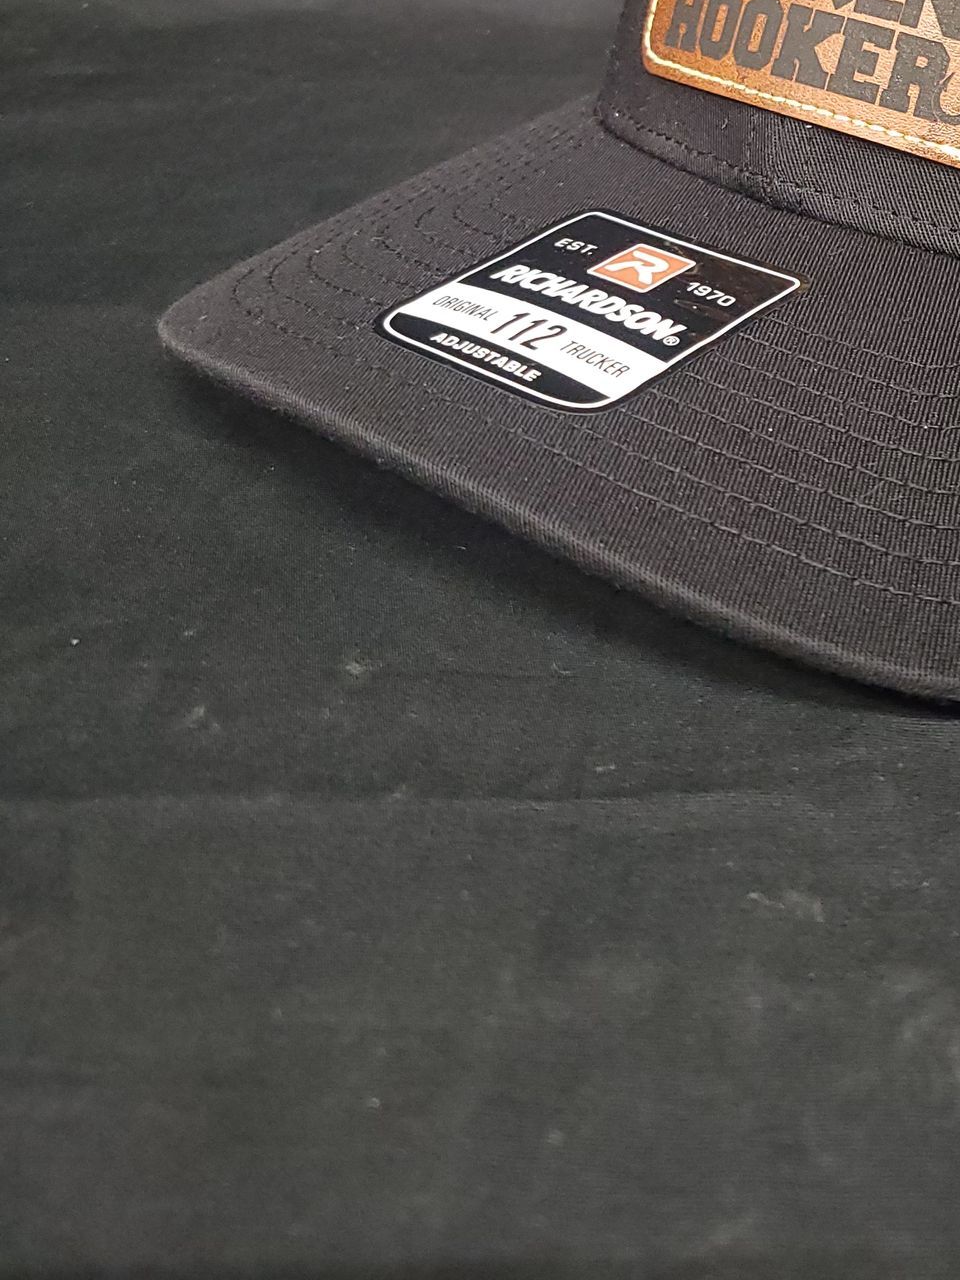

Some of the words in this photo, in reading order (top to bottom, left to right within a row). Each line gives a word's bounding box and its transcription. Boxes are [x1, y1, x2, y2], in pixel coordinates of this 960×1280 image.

[554, 237, 599, 256] EST.
[686, 280, 738, 308] 1970
[430, 331, 542, 383] ADJUSTABLE
[432, 294, 500, 323] ORIGINAL
[494, 311, 569, 351] 112
[558, 340, 631, 379] TRUCKER
